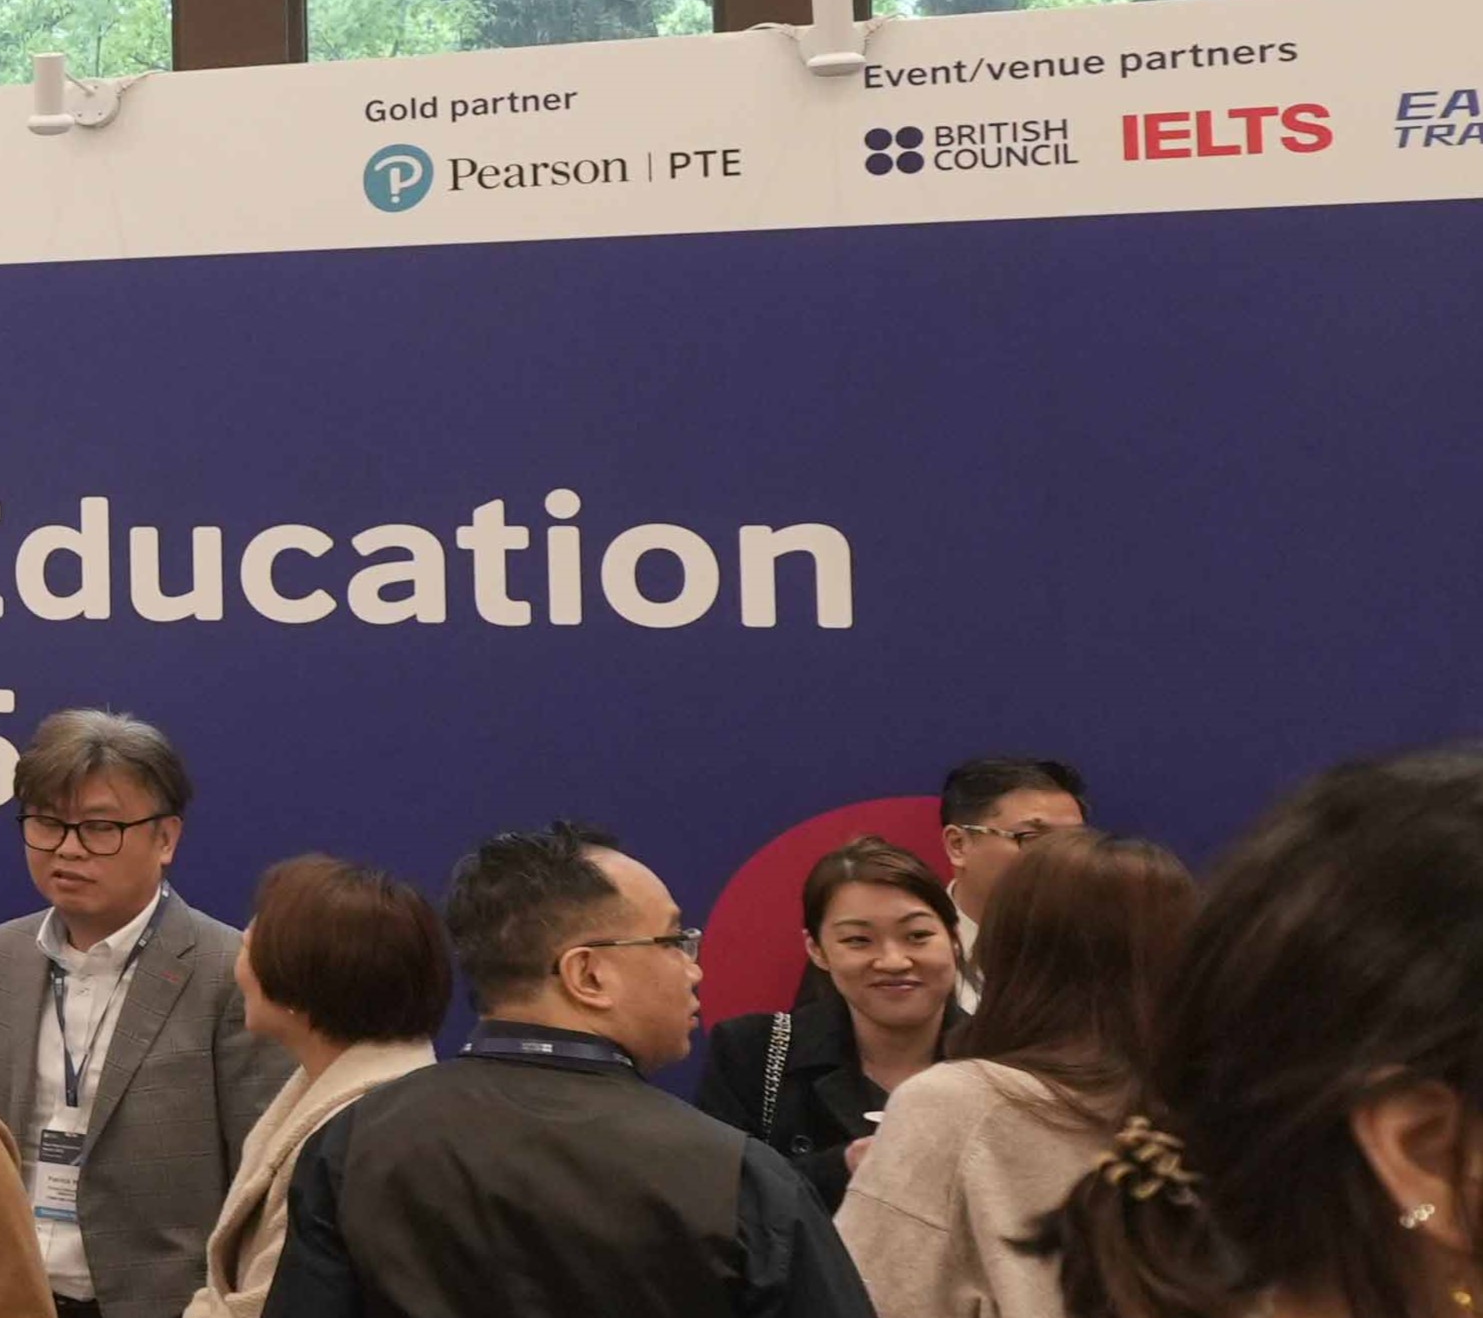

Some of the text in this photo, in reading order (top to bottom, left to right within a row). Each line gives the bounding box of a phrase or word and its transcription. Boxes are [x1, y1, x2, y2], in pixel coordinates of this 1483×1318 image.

[863, 41, 1298, 89] Event/venue partners
[364, 90, 579, 122] Gold partner
[934, 119, 1069, 147] BRITISH
[1122, 103, 1334, 161] IELTS
[447, 149, 742, 191] Pearson PTE
[933, 144, 1079, 171] COUNCIL
